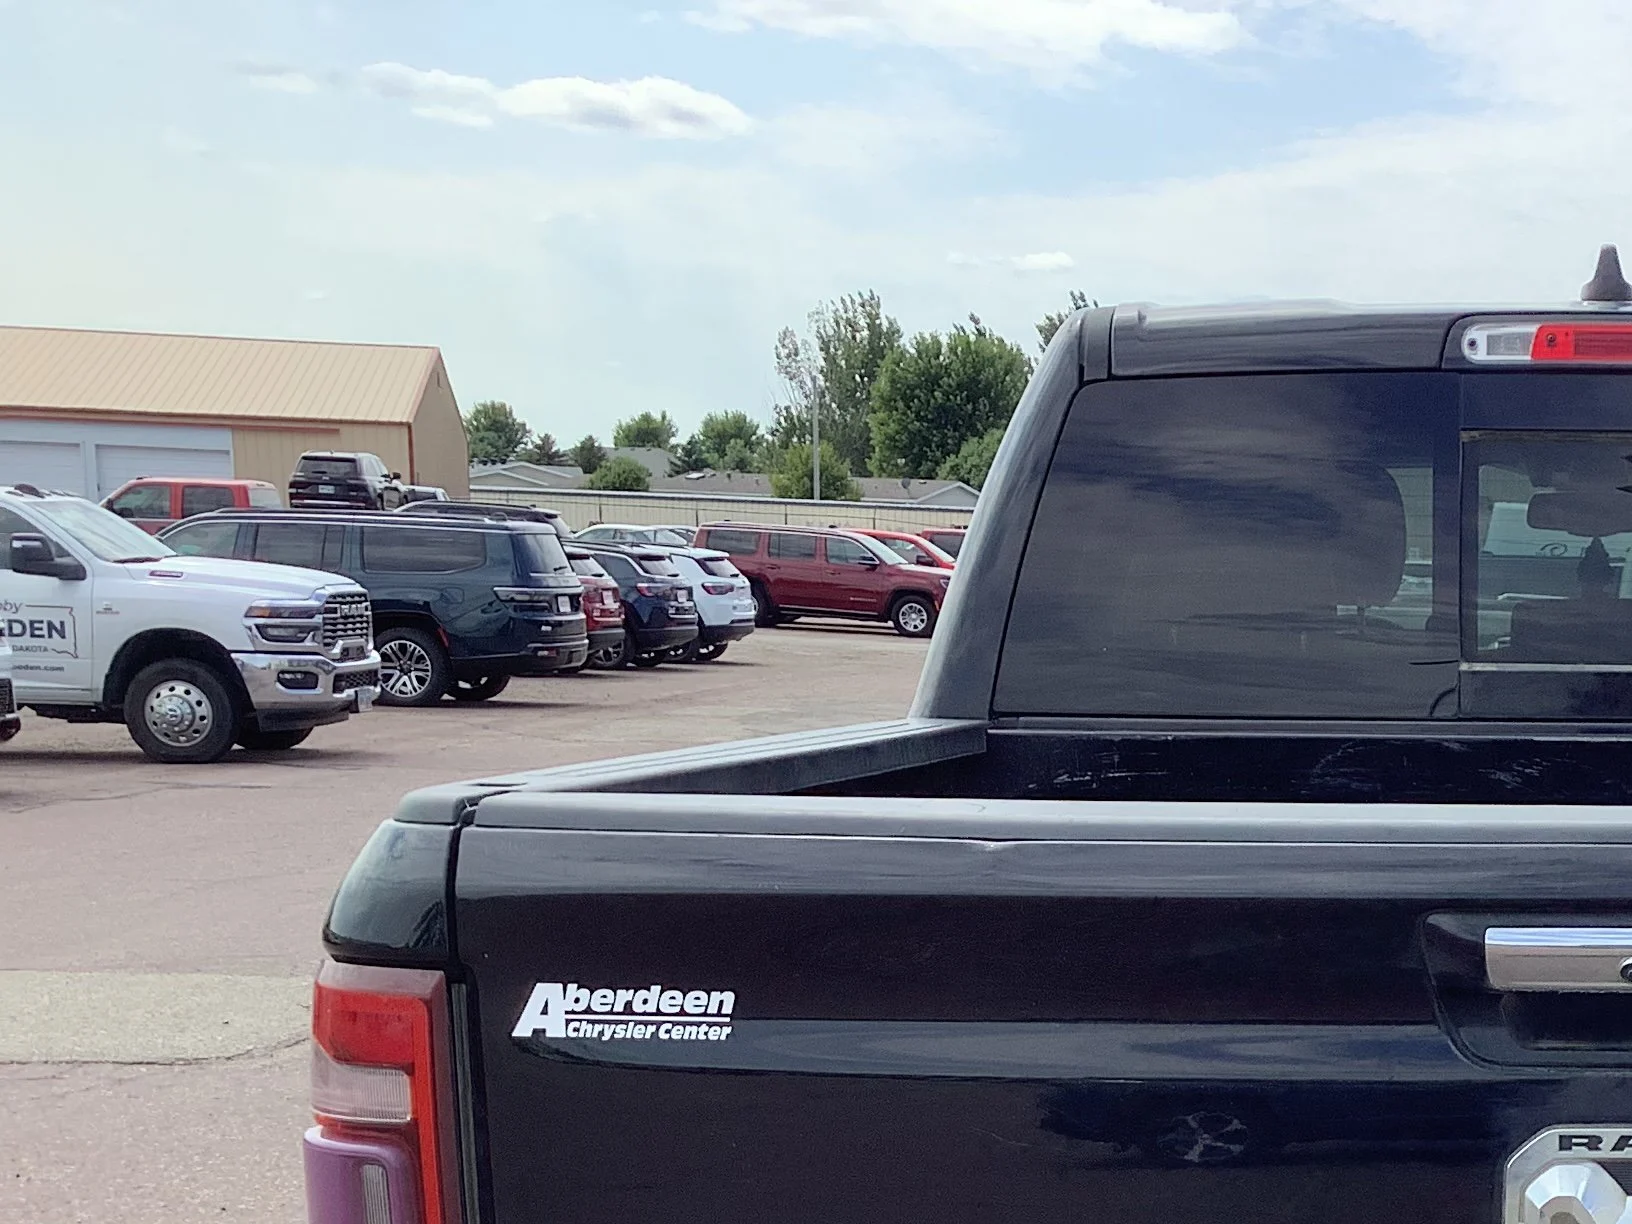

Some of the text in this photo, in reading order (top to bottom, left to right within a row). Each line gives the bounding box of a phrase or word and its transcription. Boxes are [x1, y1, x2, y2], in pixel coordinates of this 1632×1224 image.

[0, 599, 23, 614] by
[12, 645, 49, 653] DAKOTA
[512, 982, 736, 1038] Aberdeen
[567, 1020, 732, 1041] Chrysler Center
